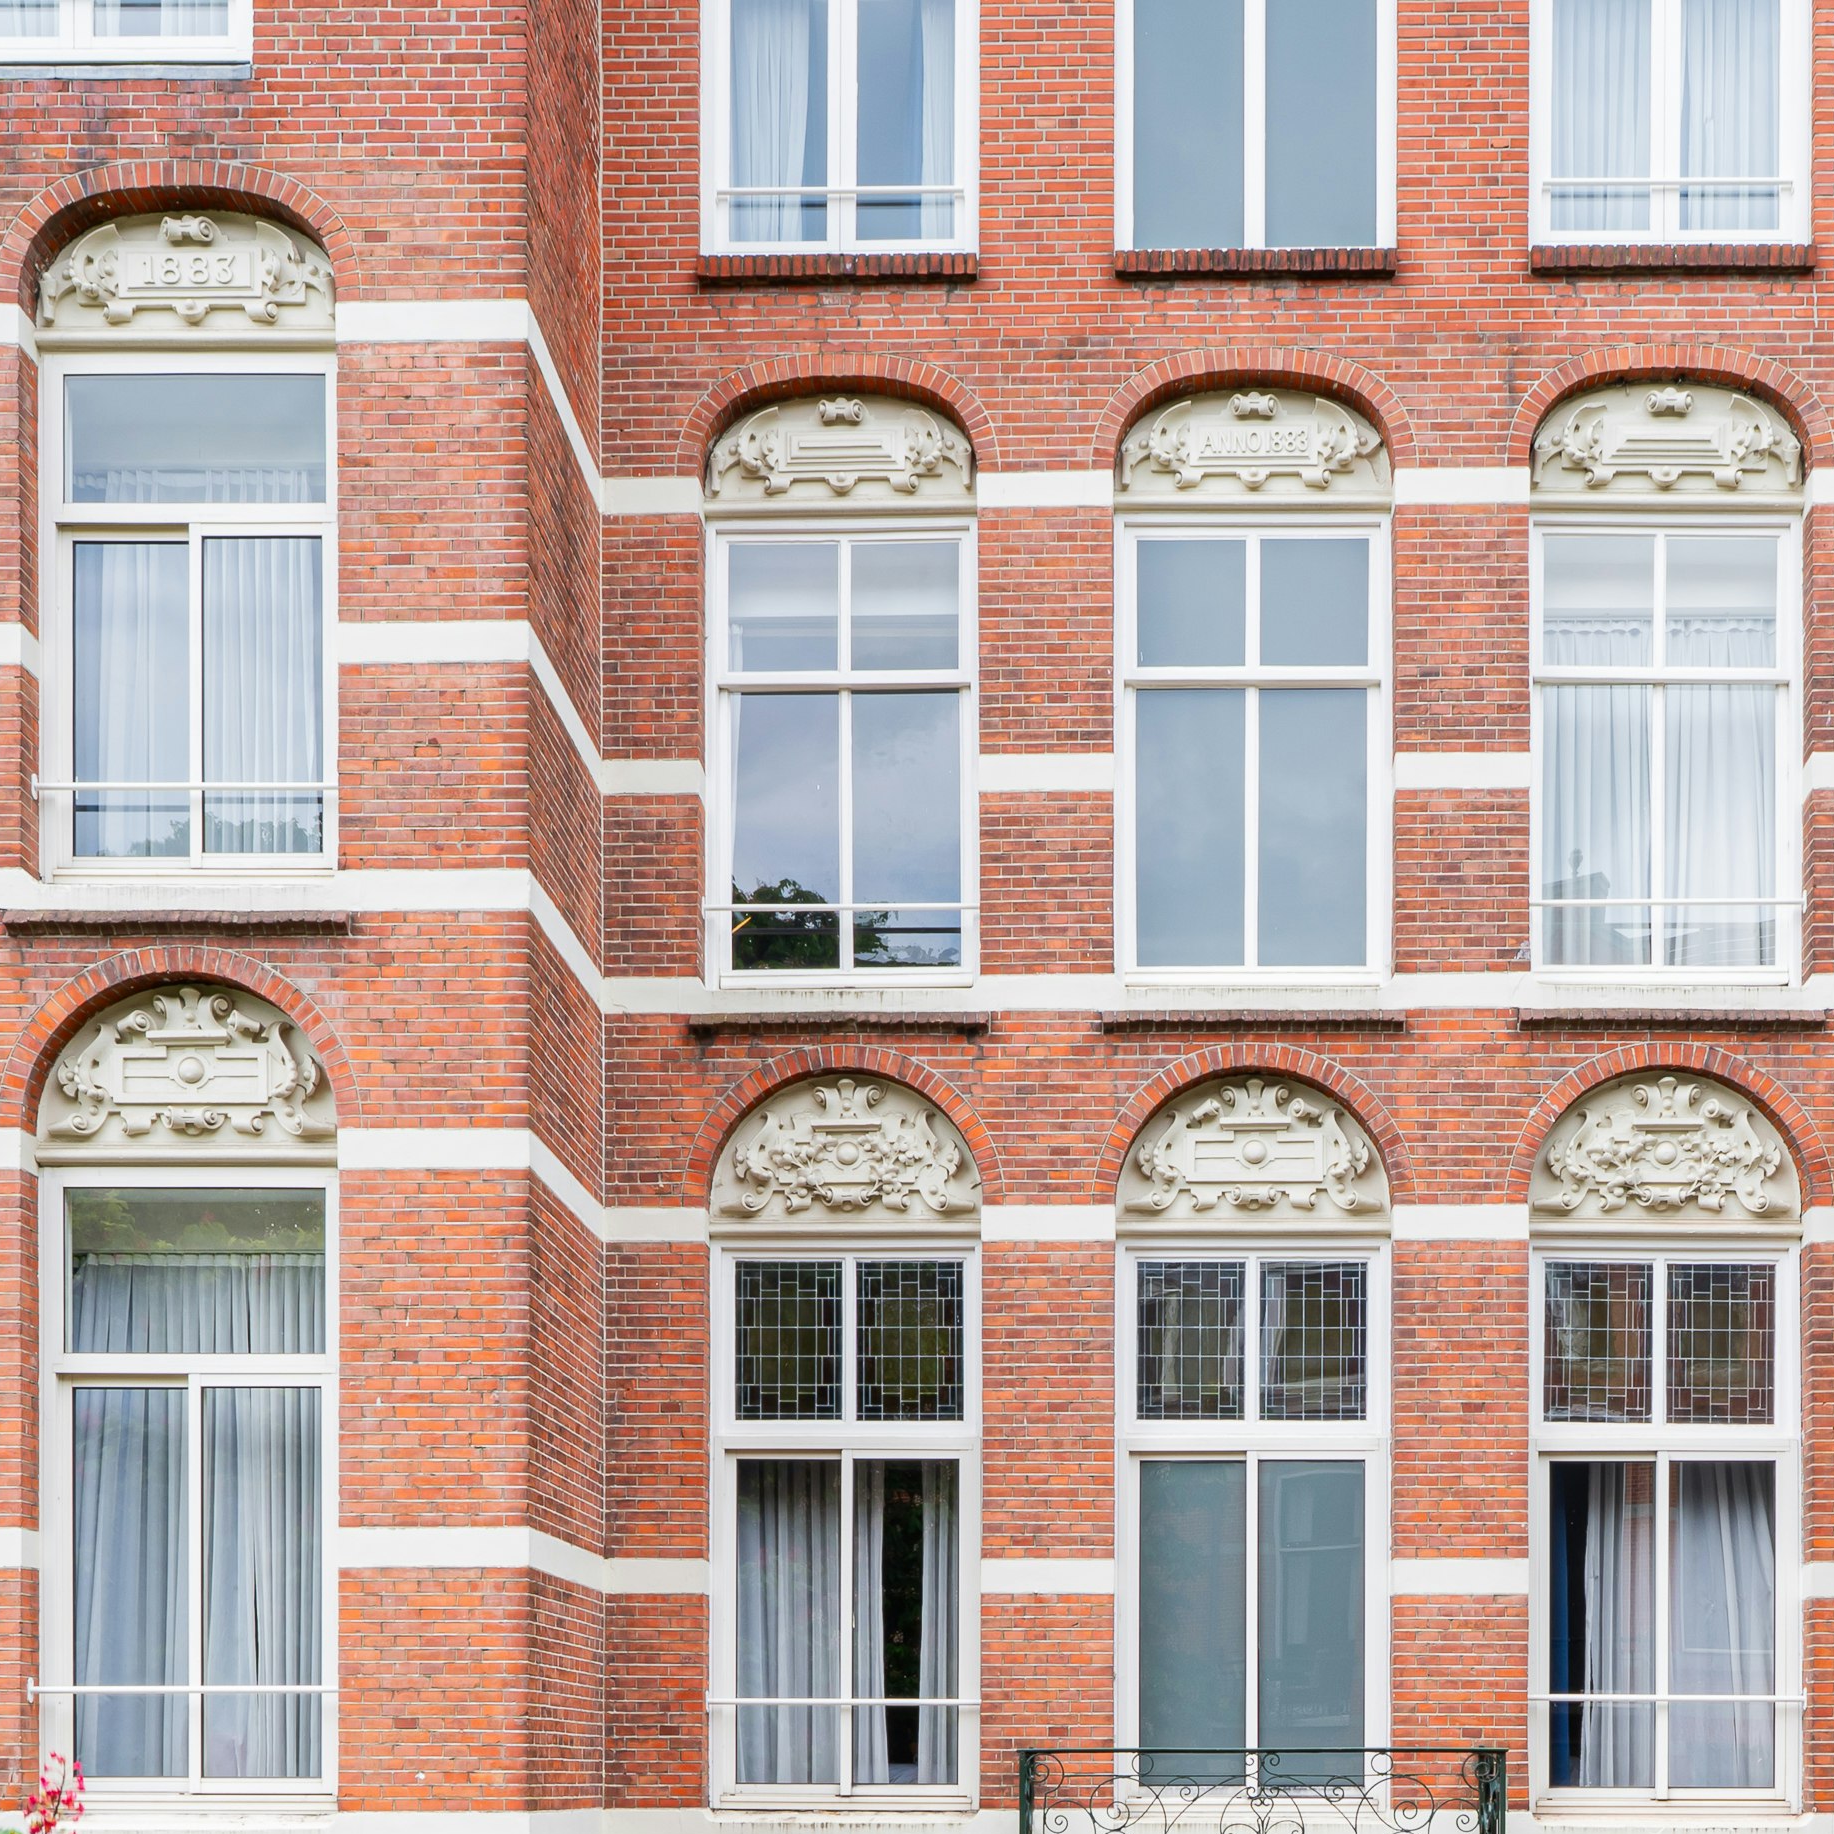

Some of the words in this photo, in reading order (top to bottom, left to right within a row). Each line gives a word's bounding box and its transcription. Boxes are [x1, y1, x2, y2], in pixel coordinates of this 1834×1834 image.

[142, 255, 236, 285] 1883
[1200, 428, 1264, 454] ANNO
[1265, 428, 1309, 454] 1883
